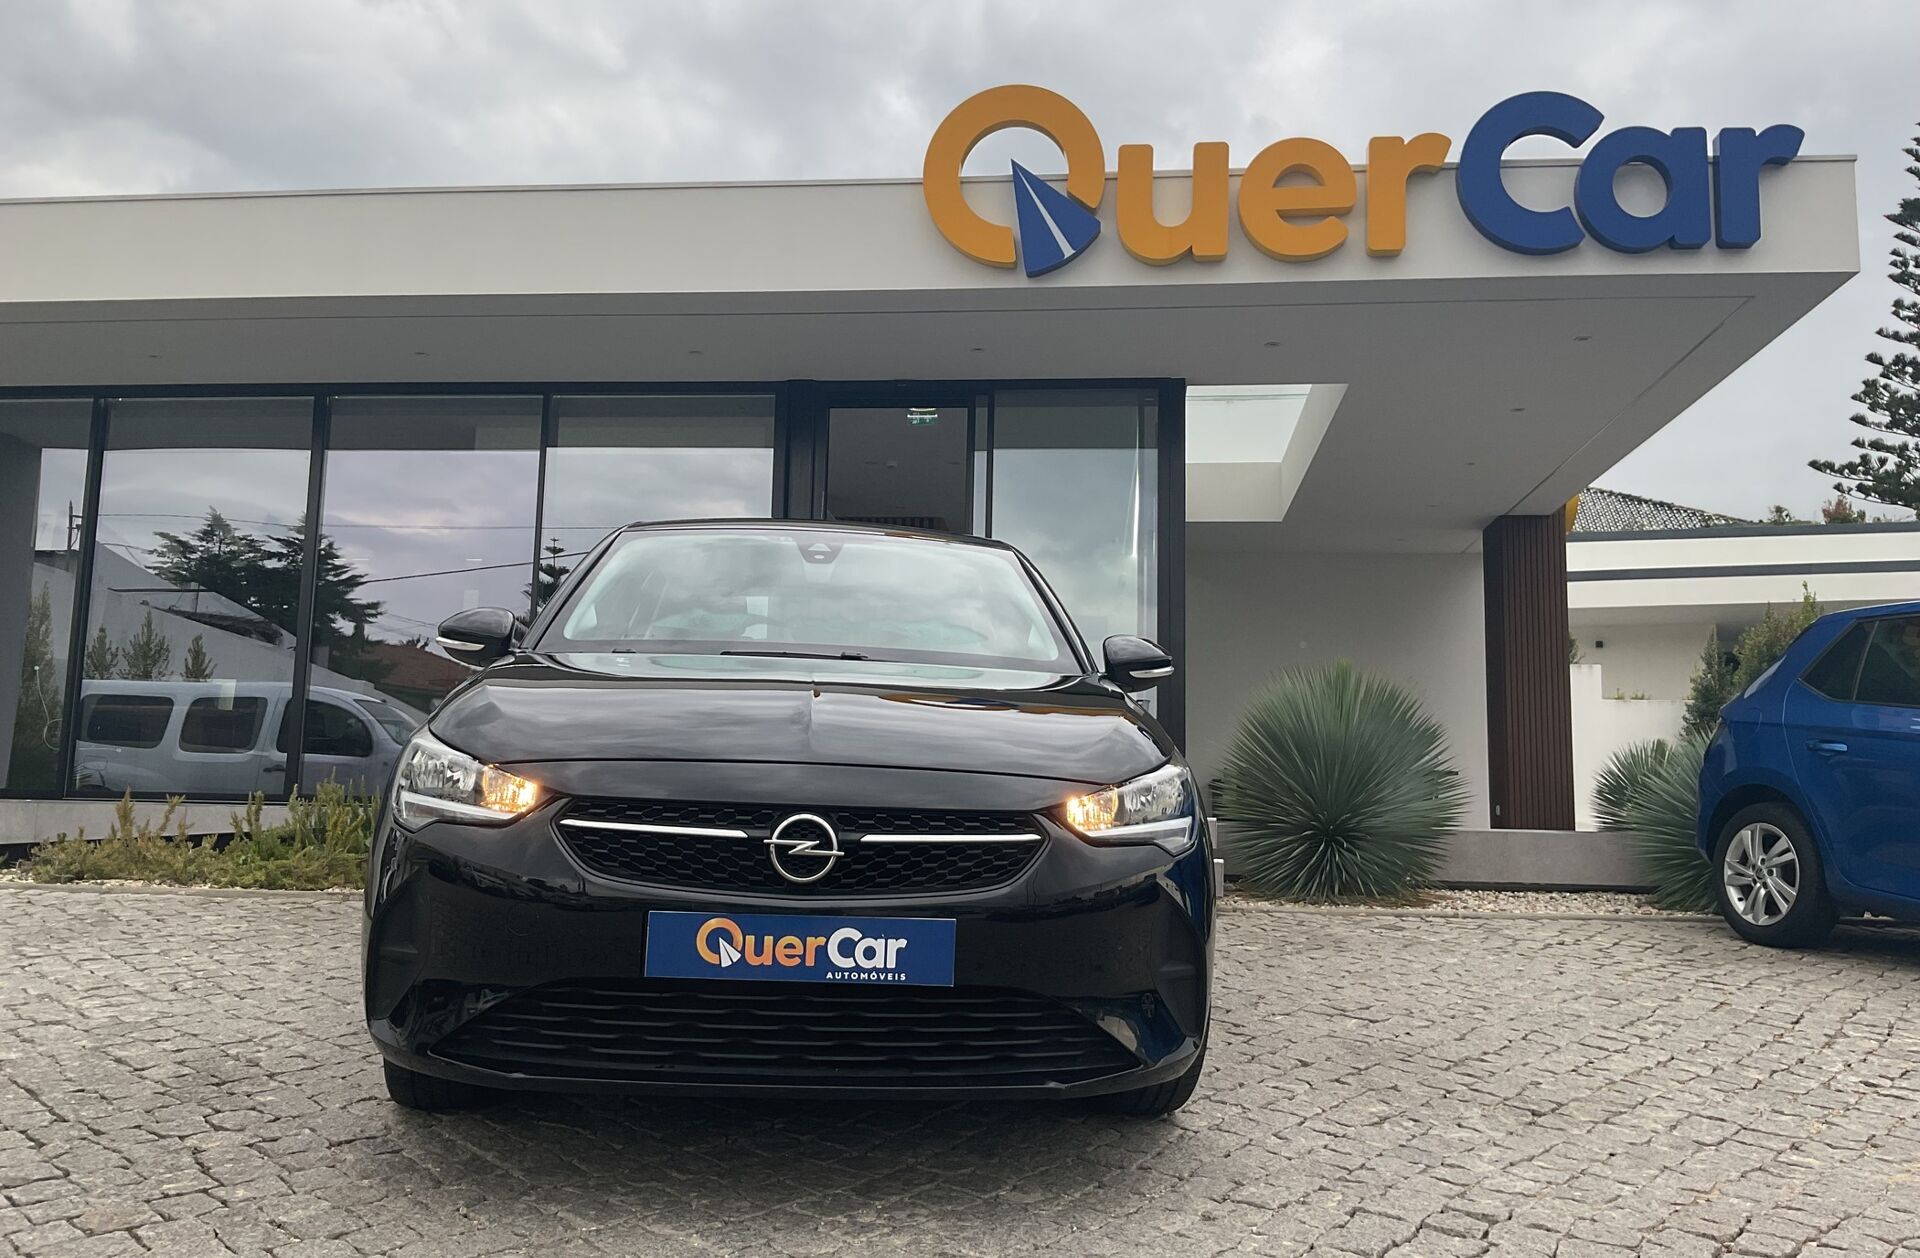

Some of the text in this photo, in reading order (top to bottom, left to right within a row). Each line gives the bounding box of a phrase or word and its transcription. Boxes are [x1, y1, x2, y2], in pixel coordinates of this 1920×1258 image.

[923, 84, 1804, 278] QuerCar
[696, 917, 907, 968] QuerCar
[826, 970, 906, 981] AUTOMÓVEIS
